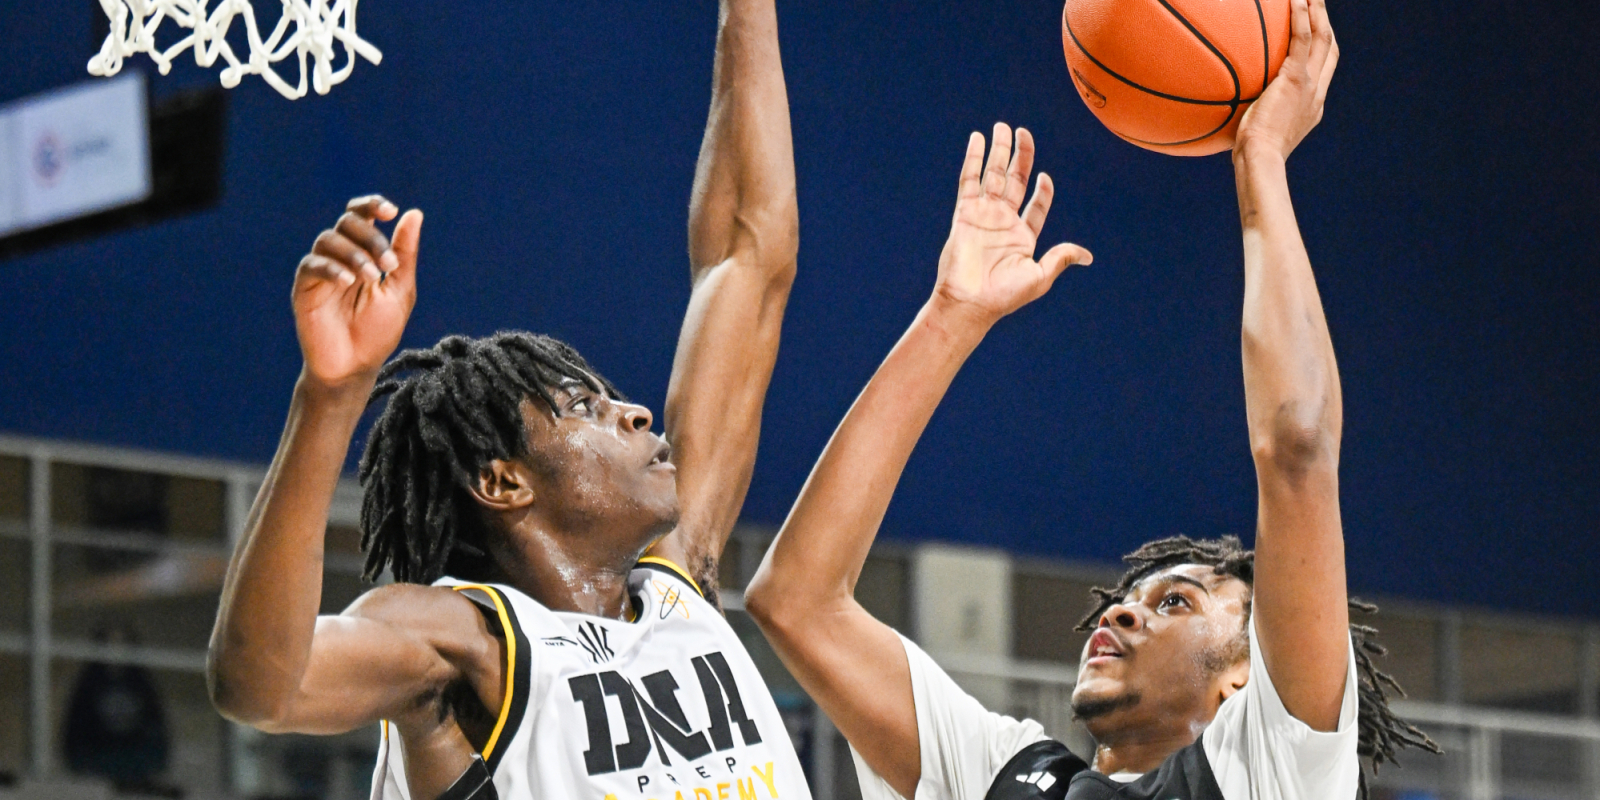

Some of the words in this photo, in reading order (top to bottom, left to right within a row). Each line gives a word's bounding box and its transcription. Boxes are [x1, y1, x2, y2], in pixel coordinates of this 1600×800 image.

[568, 651, 762, 776] DNA
[604, 762, 779, 800] DEMY
[637, 757, 736, 793] PREP
